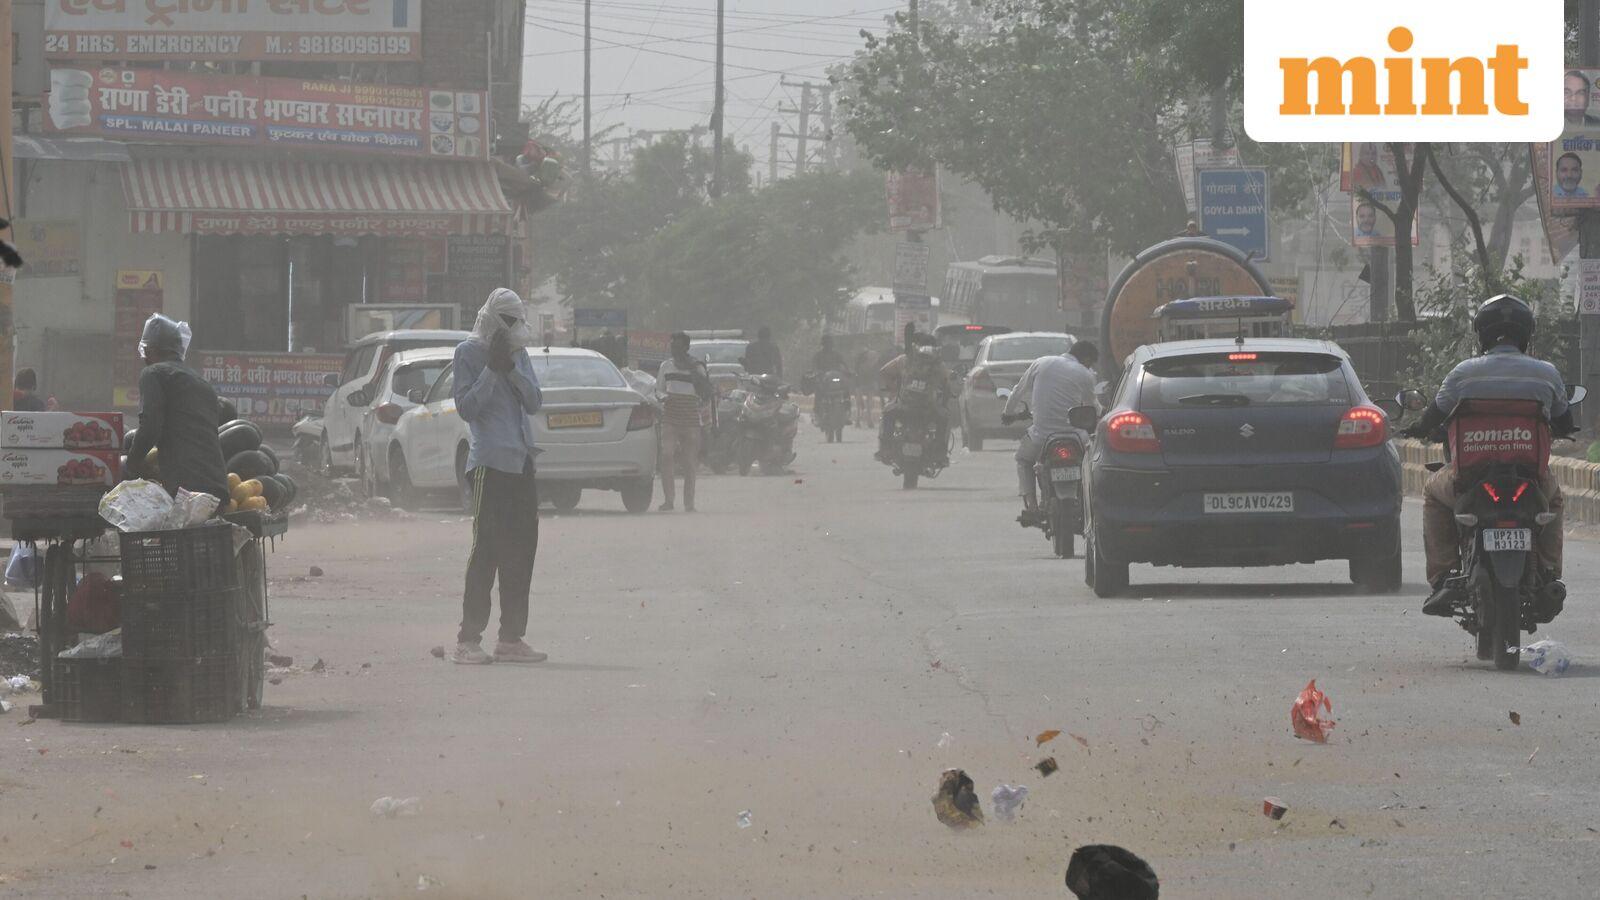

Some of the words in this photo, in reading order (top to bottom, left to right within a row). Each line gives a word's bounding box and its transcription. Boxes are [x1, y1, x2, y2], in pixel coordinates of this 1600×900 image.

[45, 34, 69, 52] 24
[76, 35, 119, 53] HRS.
[127, 34, 242, 53] EMERGENCY
[299, 36, 411, 54] 9818096199
[302, 82, 336, 93] RANA
[98, 87, 150, 112] राणा
[153, 84, 190, 115] डेरी
[203, 91, 259, 119] पनीर
[264, 99, 330, 124] भण्डार
[336, 103, 424, 130] सप्लायर
[106, 118, 138, 129] SPL.
[142, 120, 188, 133] MALAI
[192, 124, 251, 137] PANEER
[1203, 206, 1234, 215] GOYLA
[1235, 205, 1263, 215] DAIRY
[197, 217, 240, 229] राणा
[247, 215, 277, 229] डेरी
[330, 216, 382, 229] पनीर
[1463, 427, 1532, 443] zomato
[1463, 442, 1498, 452] delivers
[1499, 443, 1511, 451] on
[1513, 442, 1533, 451] time
[1212, 495, 1292, 510] DL9CAV0429
